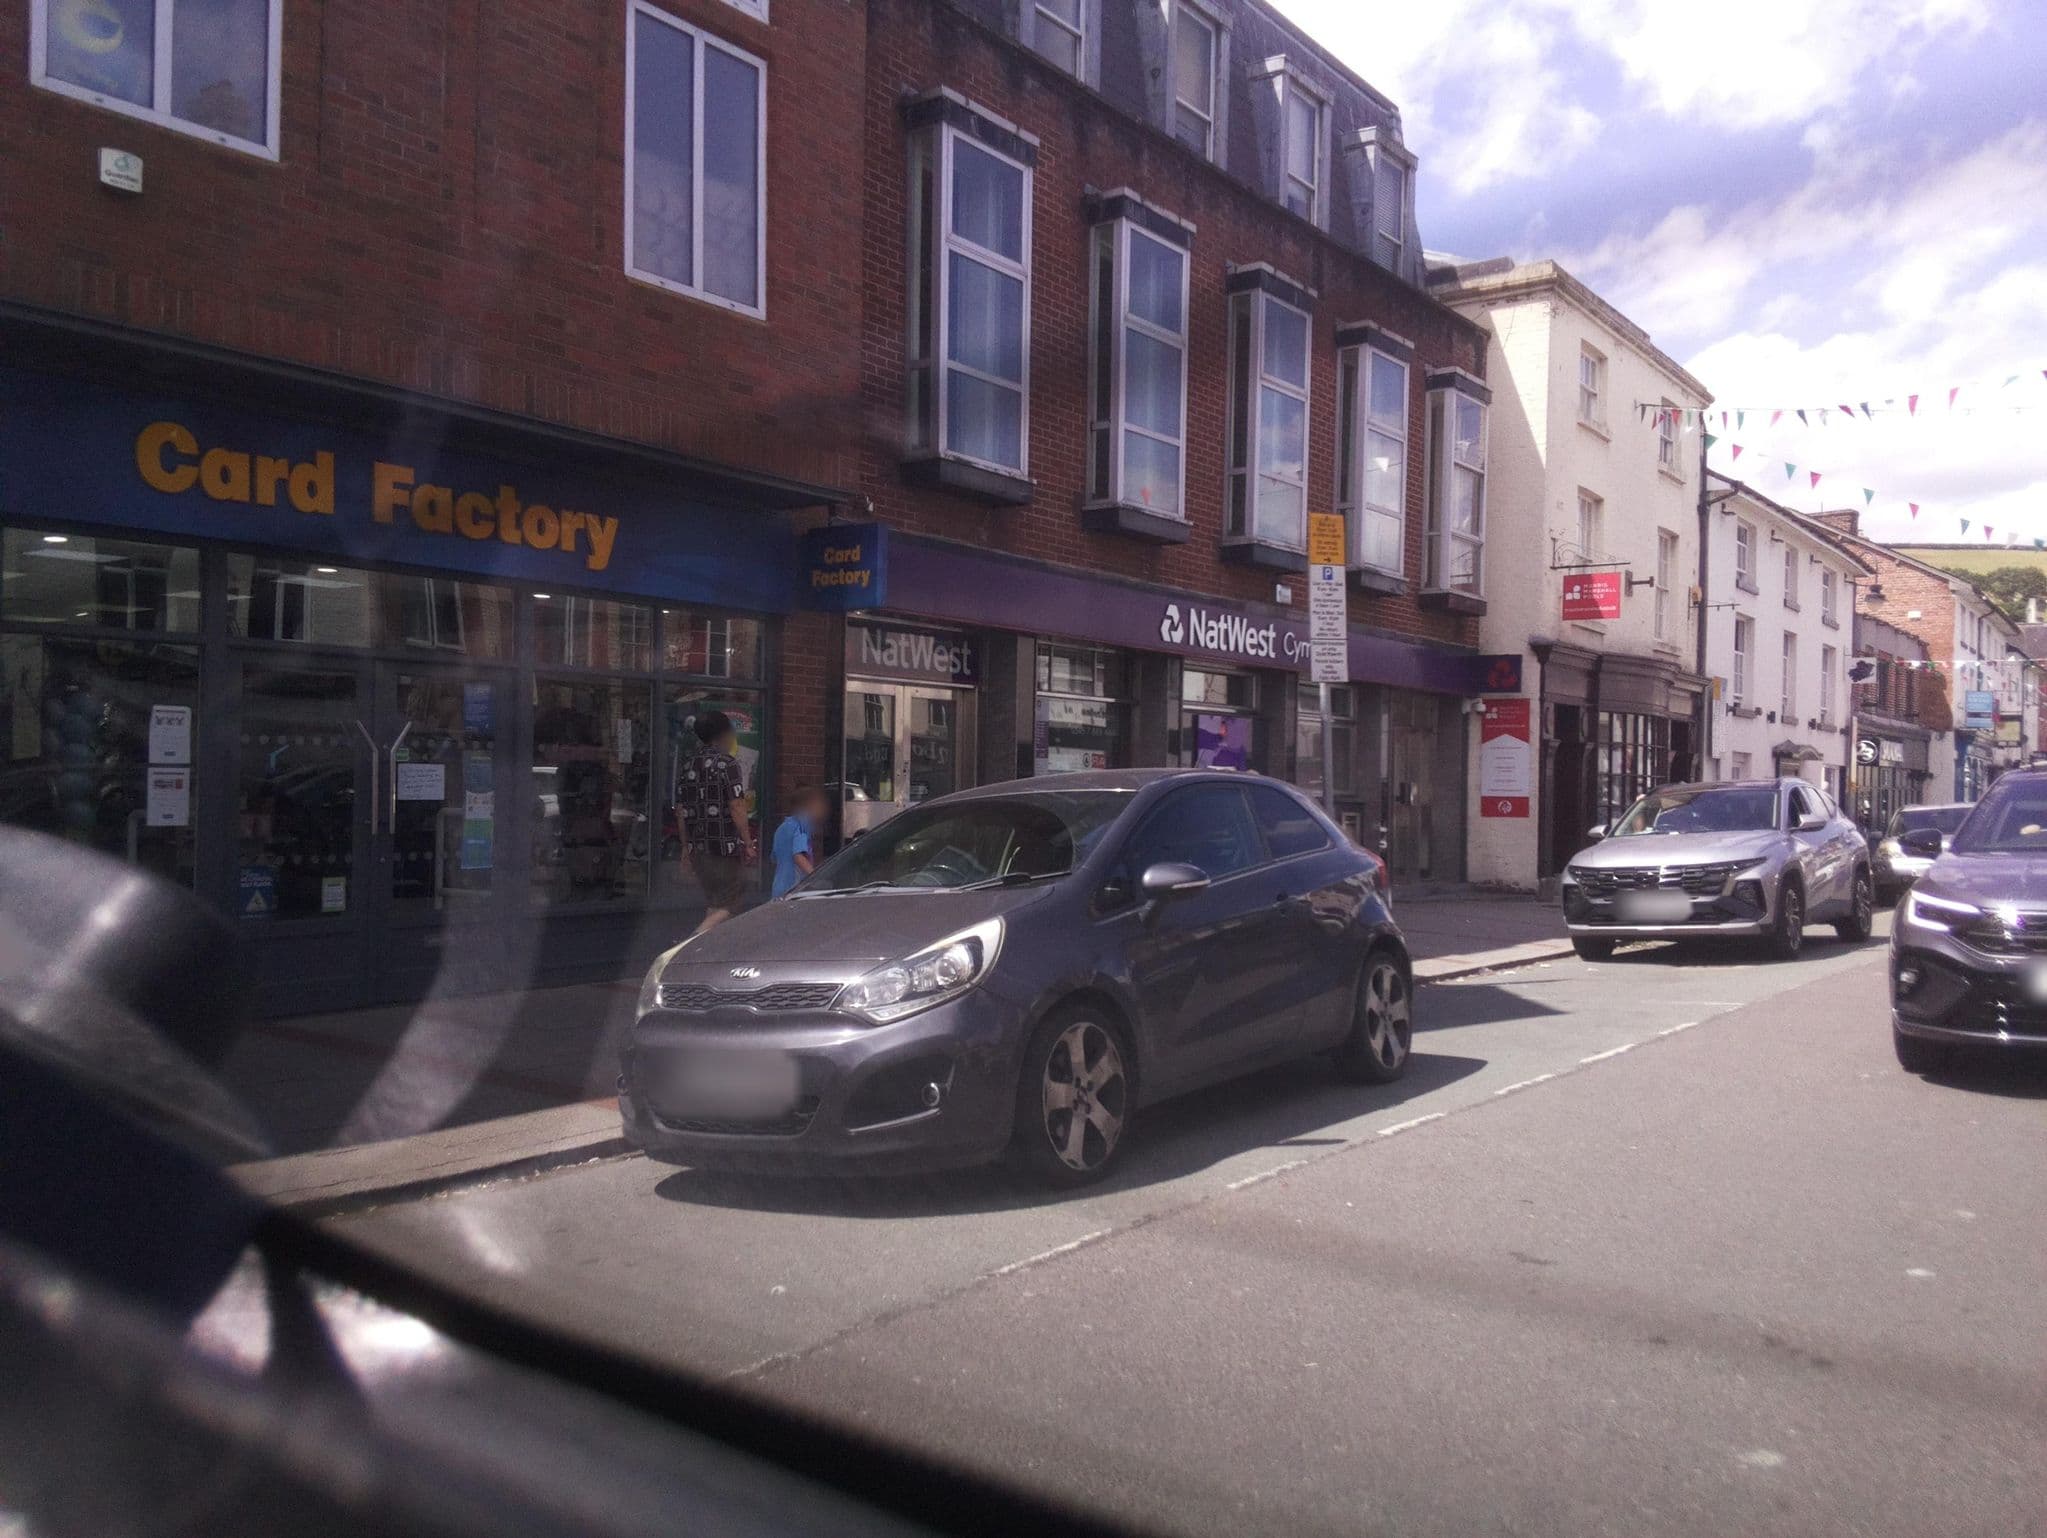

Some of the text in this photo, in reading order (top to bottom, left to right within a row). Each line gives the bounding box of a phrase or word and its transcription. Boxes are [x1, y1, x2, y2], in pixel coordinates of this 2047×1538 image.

[135, 421, 619, 571] Card Factory
[811, 569, 872, 588] Factory
[824, 544, 862, 565] Card
[861, 627, 972, 675] NatWest
[1189, 608, 1276, 658] NatWest
[1283, 632, 1311, 664] Cym
